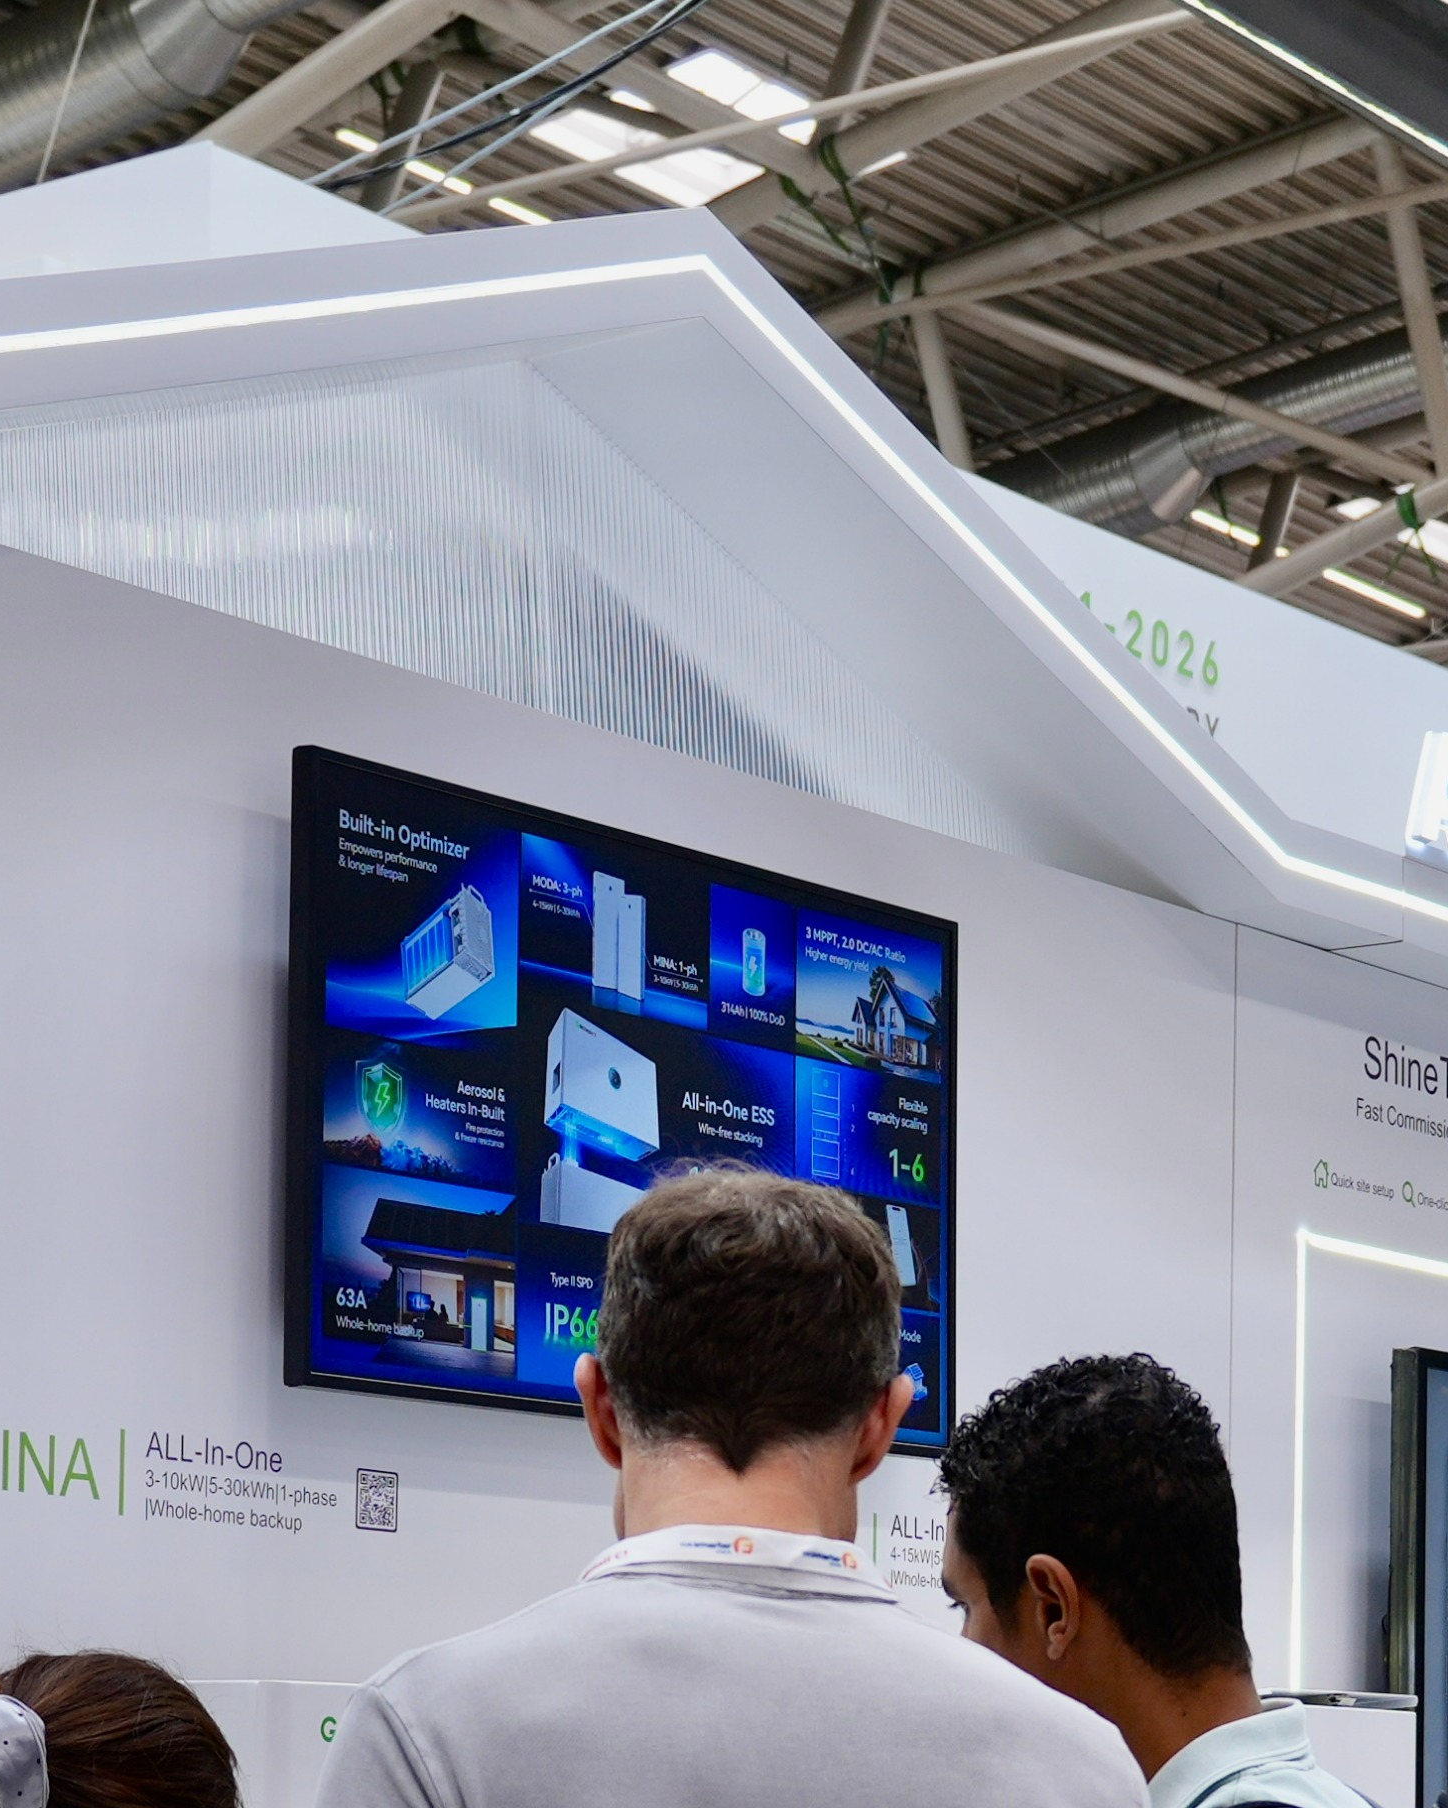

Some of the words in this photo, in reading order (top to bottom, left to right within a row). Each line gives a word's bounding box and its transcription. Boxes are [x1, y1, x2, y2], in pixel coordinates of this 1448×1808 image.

[339, 808, 395, 841] Built-in
[398, 824, 470, 860] Optimizer
[338, 837, 384, 860] Empowers
[384, 850, 438, 874] performance
[338, 854, 347, 868] &
[347, 856, 375, 876] longer
[376, 863, 409, 883] lifespan
[532, 874, 562, 893] MODA:
[563, 882, 583, 898] 3-ph
[805, 926, 812, 939] 3
[841, 936, 855, 951] 2.0
[856, 939, 884, 959] DC/AC
[884, 946, 906, 964] Ratio
[654, 954, 677, 971] MINA:
[678, 962, 698, 978] 1-ph
[805, 946, 828, 965] Higher
[829, 955, 852, 971] energy
[852, 959, 870, 973] yield
[769, 1011, 786, 1027] DoD
[456, 1080, 497, 1101] Aerosol
[497, 1088, 506, 1102] &
[425, 1093, 467, 1115] Heaters
[467, 1101, 506, 1122] In-Built
[681, 1090, 749, 1121] All-in-One
[751, 1104, 775, 1127] ESS
[898, 1096, 929, 1115] Flexible
[1356, 1097, 1384, 1123] Fast
[697, 1121, 733, 1142] Wire-free
[733, 1127, 764, 1149] stacking
[867, 1110, 901, 1129] capacity
[901, 1114, 928, 1135] scaling
[888, 1148, 925, 1182] 1-6
[1330, 1171, 1354, 1190] Quick
[1356, 1178, 1371, 1195] site
[1372, 1182, 1395, 1201] setup
[550, 1272, 570, 1288] Type
[576, 1276, 594, 1290] SPD
[336, 1286, 368, 1310] 63A
[335, 1314, 392, 1334] Whole-home
[544, 1301, 599, 1339] IP66
[145, 1431, 284, 1473] ALL-In-One
[249, 1509, 303, 1535] backup
